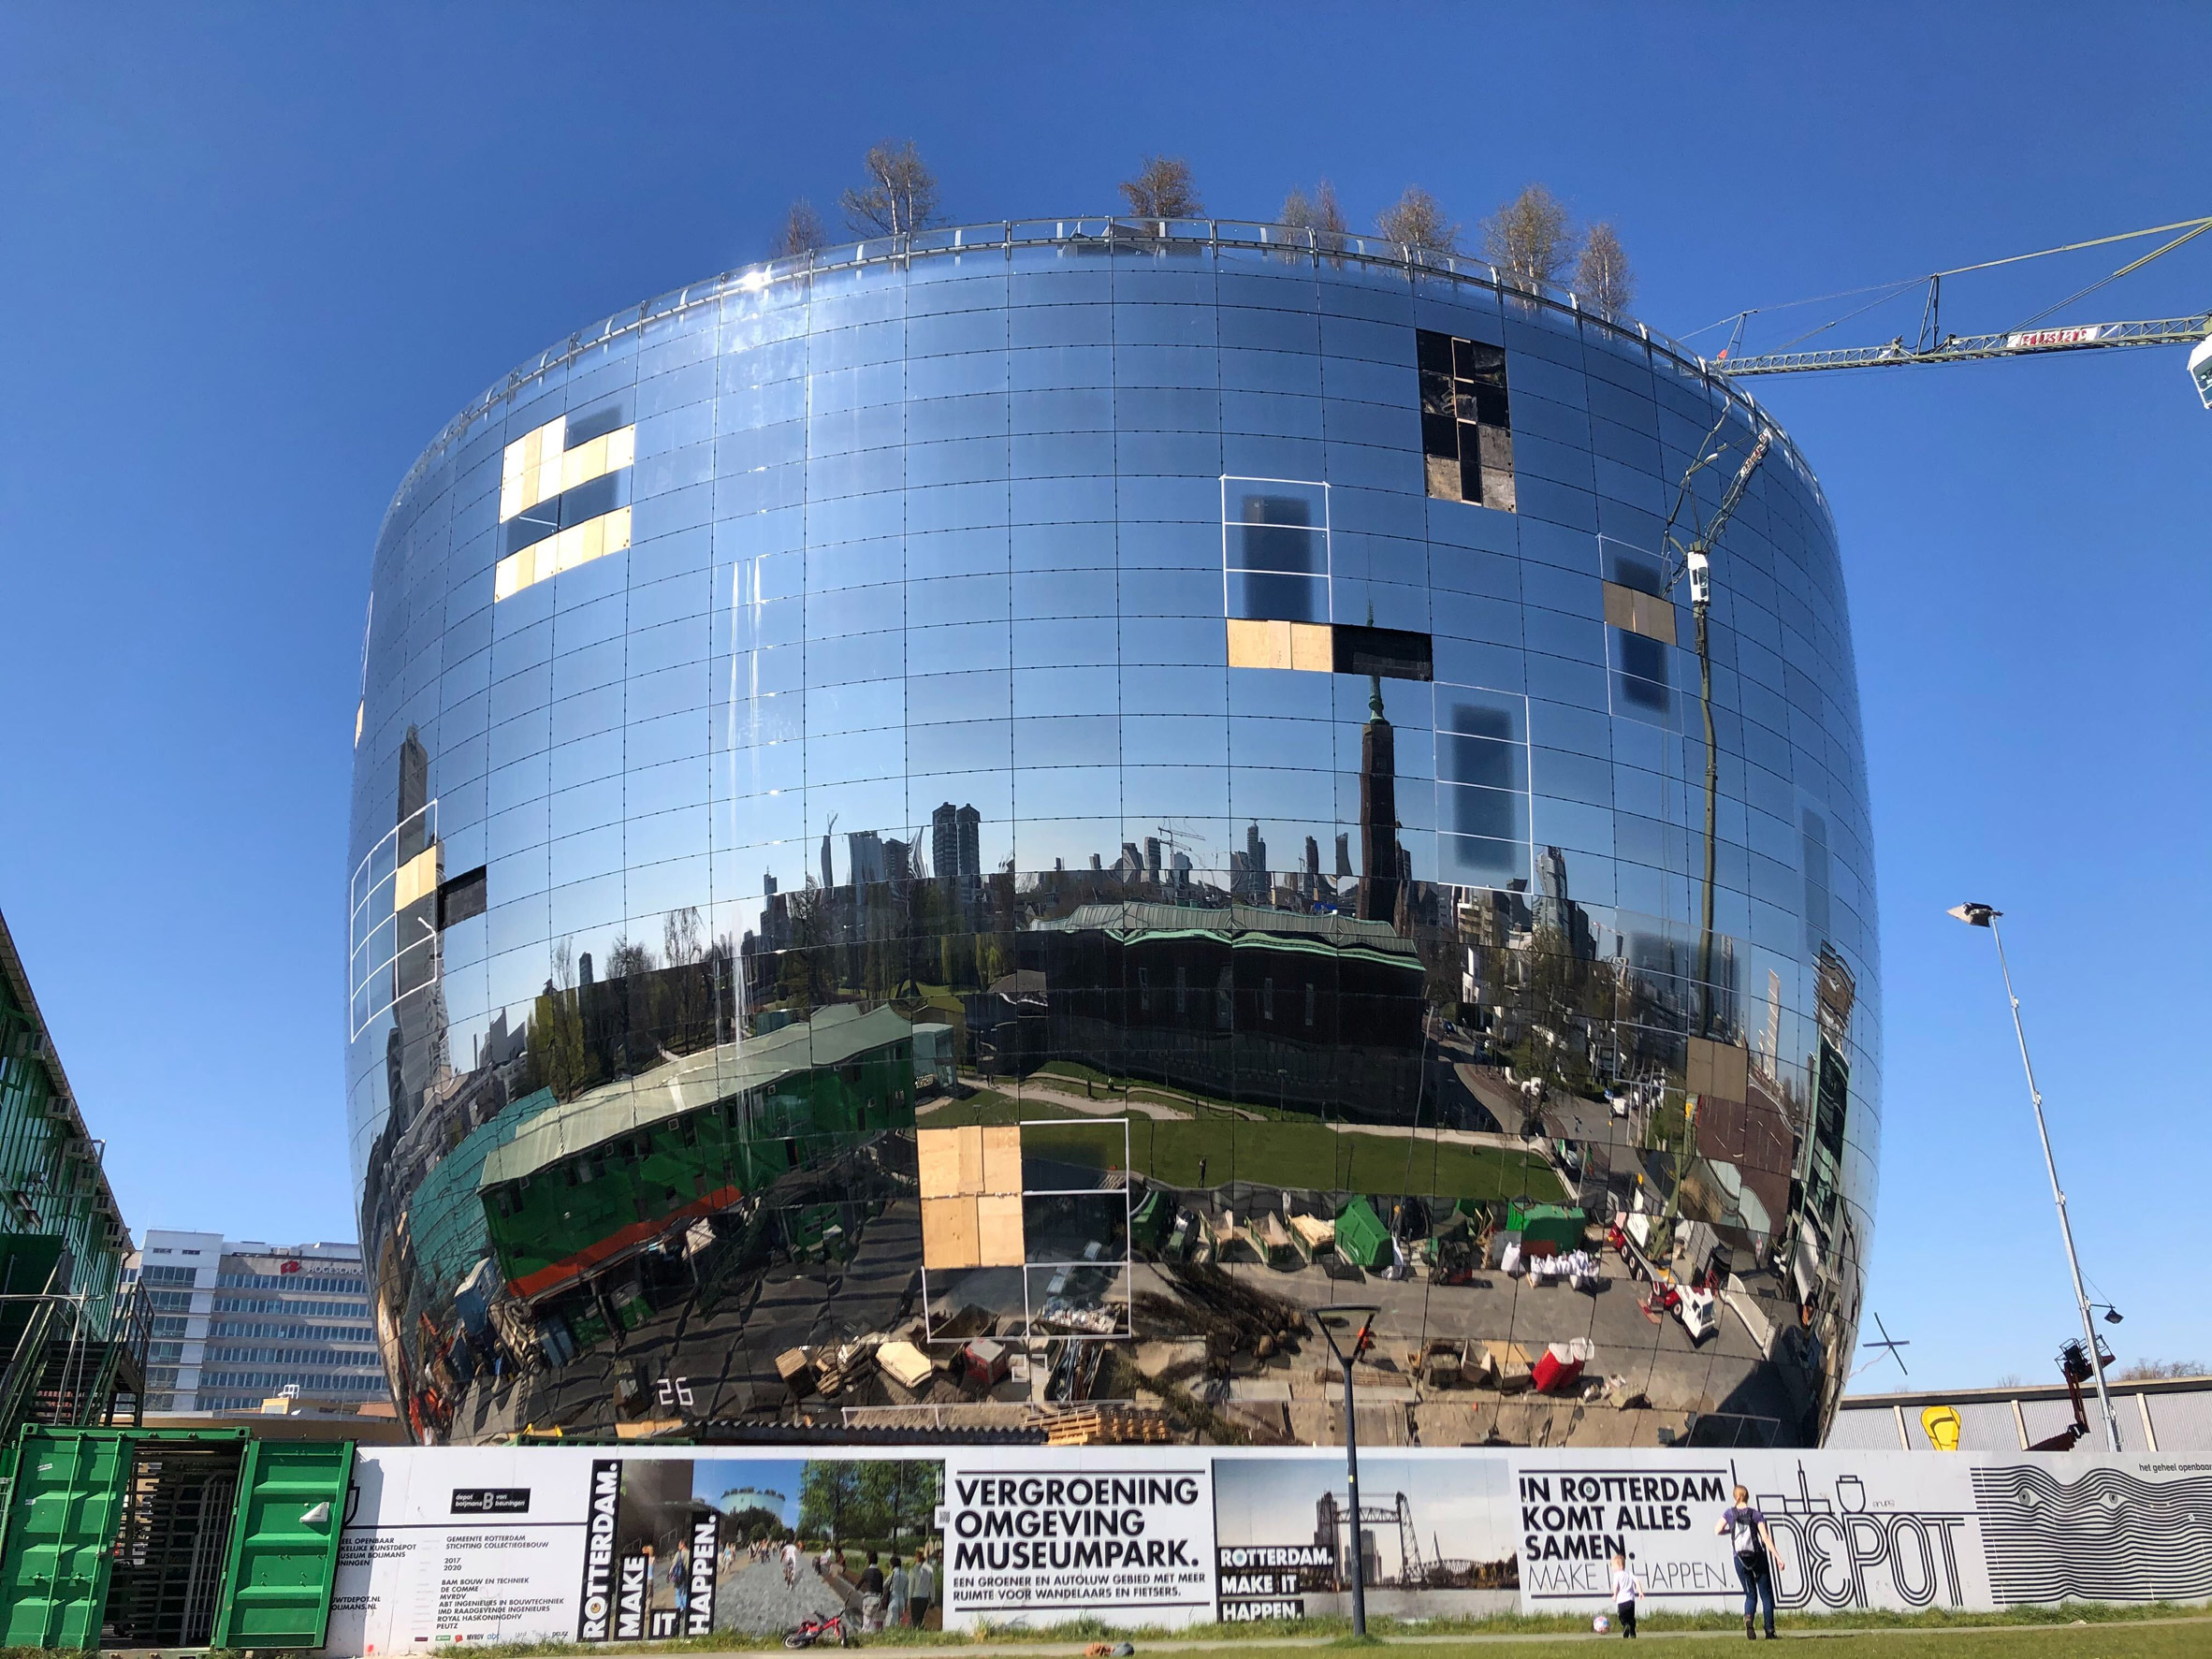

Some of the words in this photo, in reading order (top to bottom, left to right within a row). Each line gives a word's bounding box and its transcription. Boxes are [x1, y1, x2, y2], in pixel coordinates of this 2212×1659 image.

[657, 1376, 694, 1406] 26
[2139, 1463, 2152, 1472] het
[2152, 1463, 2177, 1473] geheel
[455, 1493, 473, 1502] depot
[953, 1477, 1199, 1507] VERGROENING
[1519, 1477, 1550, 1503] IN
[1560, 1477, 1726, 1503] ROTTERDAM
[954, 1508, 1145, 1538] OMGEVING
[1521, 1506, 1606, 1532] KOMT
[1616, 1505, 1692, 1531] ALLES
[583, 1462, 618, 1638] ROTTERDAM.
[953, 1539, 1200, 1571] MUSEUMPARK.
[1220, 1547, 1333, 1567] ROTTERDAM.
[1525, 1534, 1636, 1562] SAMEN.
[1763, 1512, 1966, 1609] DEPOT
[689, 1514, 717, 1636] HAPPEN.
[953, 1577, 974, 1588] EEN
[978, 1576, 1031, 1588] GROENER
[1035, 1576, 1050, 1587] EN
[1054, 1574, 1110, 1586] AUTOLUW
[1113, 1574, 1150, 1585] GEBIED
[1153, 1573, 1174, 1583] MET
[1177, 1572, 1205, 1583] MEER
[1221, 1574, 1273, 1594] MAKE
[1281, 1574, 1297, 1593] IT
[1528, 1563, 1598, 1591] MAKE
[1632, 1561, 1734, 1590] HAPPEN.
[618, 1556, 648, 1637] MAKE
[953, 1590, 994, 1602] RUIMTE
[997, 1589, 1031, 1600] VOOR
[1035, 1588, 1112, 1600] WANDELAARS
[1115, 1587, 1130, 1597] EN
[454, 1607, 506, 1615] RAADGEVENDE
[652, 1612, 677, 1637] IT
[1222, 1601, 1302, 1622] HAPPEN.
